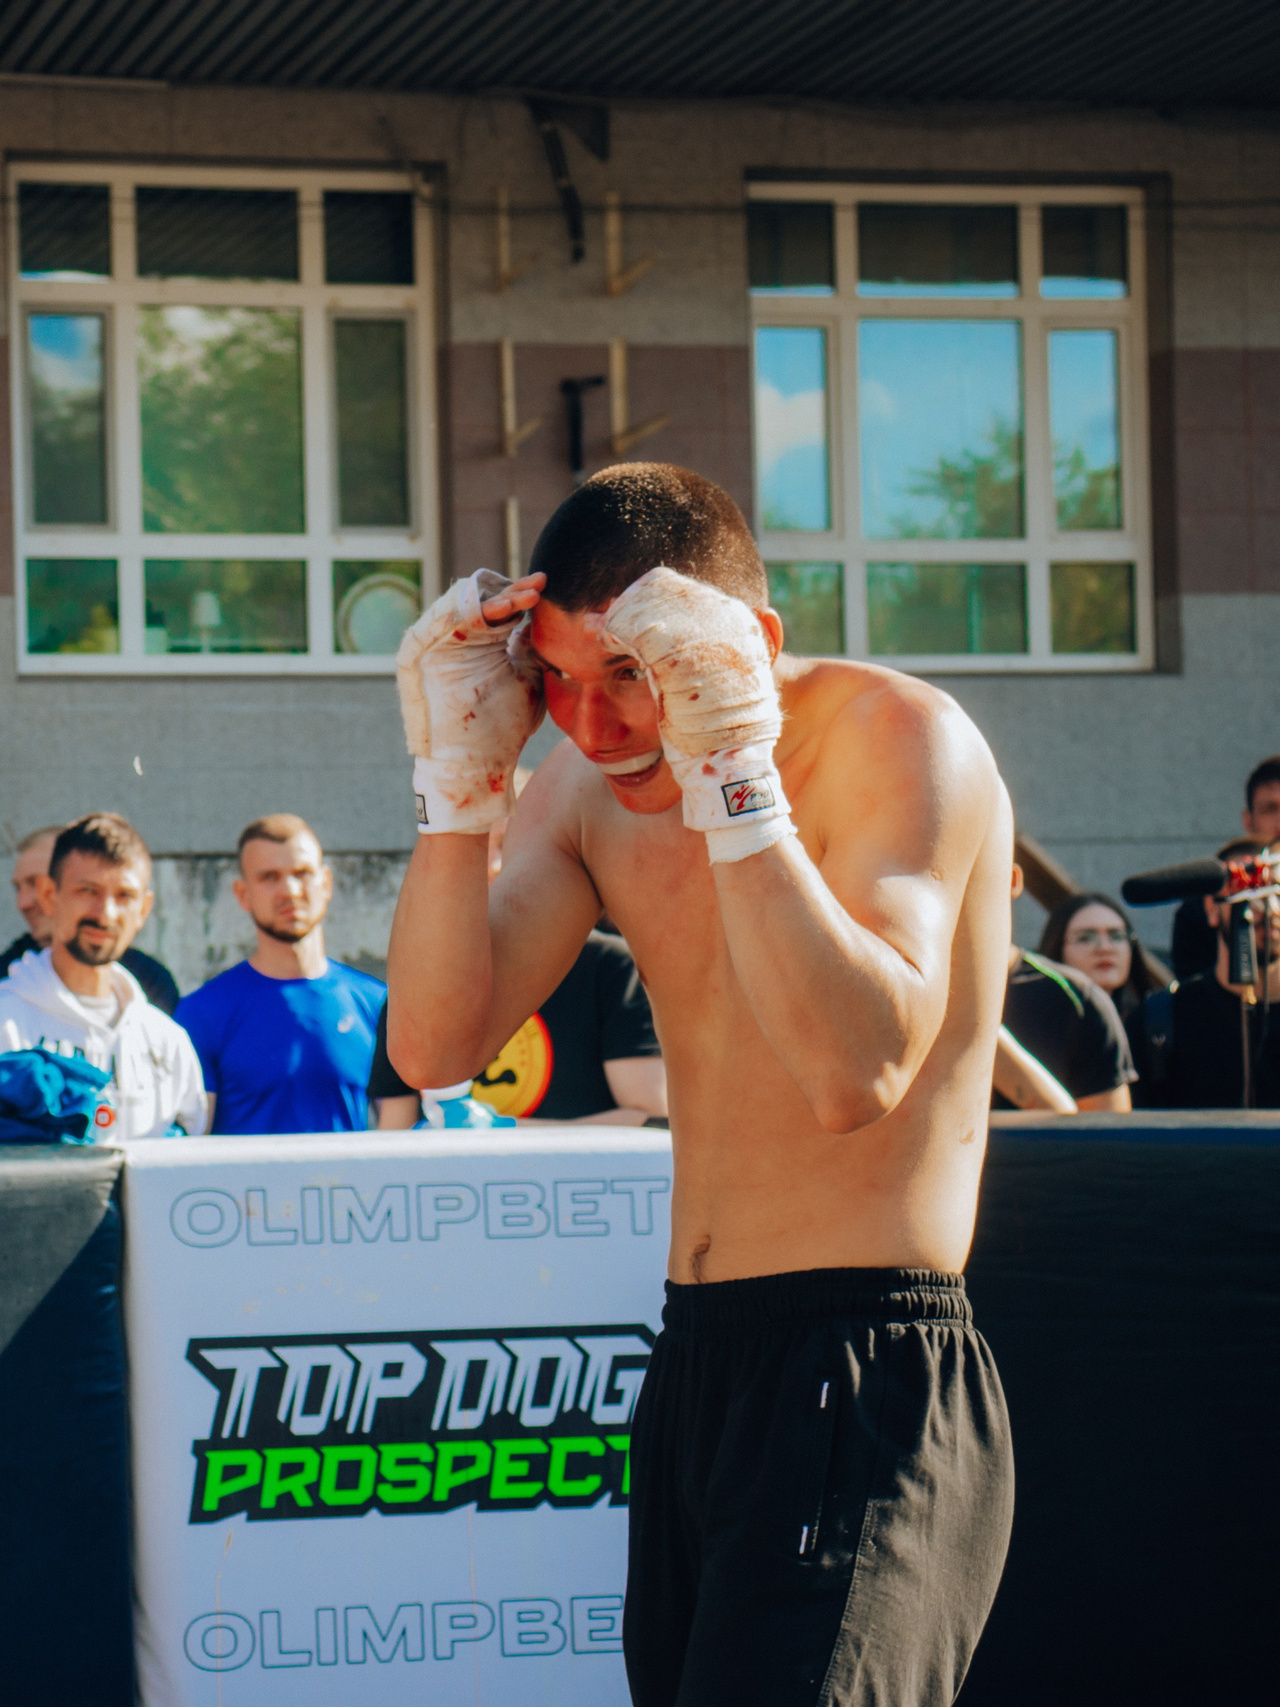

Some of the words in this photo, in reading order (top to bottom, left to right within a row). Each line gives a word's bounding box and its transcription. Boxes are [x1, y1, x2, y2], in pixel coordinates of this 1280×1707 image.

[170, 1178, 670, 1248] OLIMPBET
[198, 1341, 427, 1438] TOP
[429, 1334, 653, 1431] DOG
